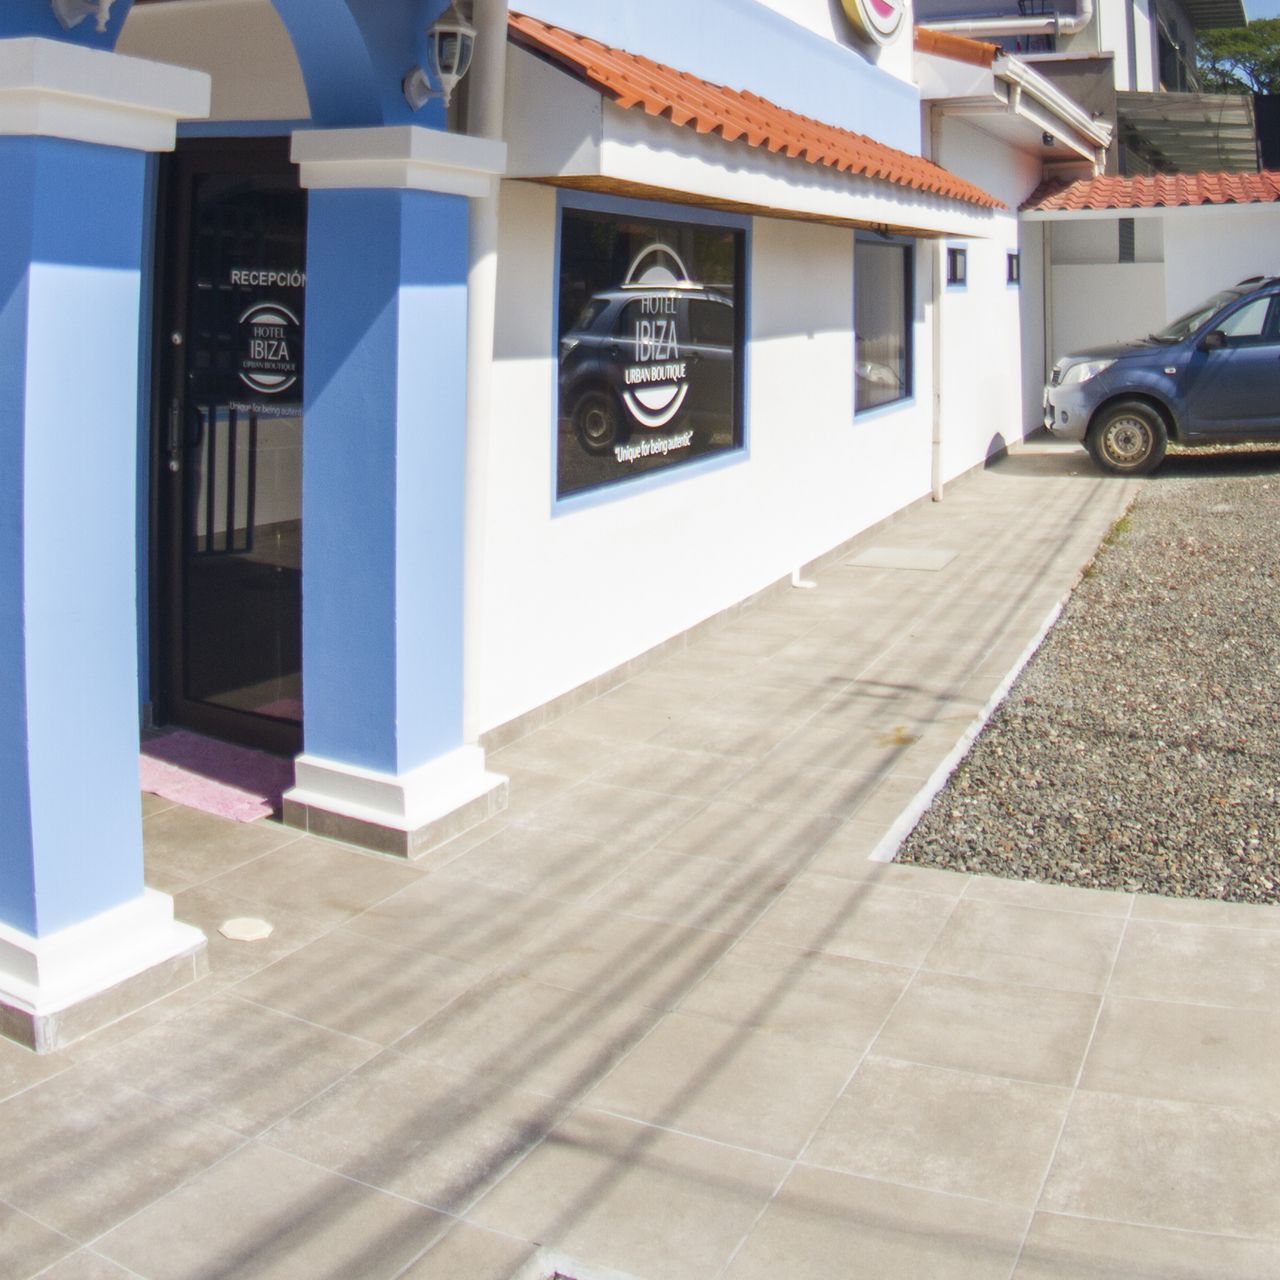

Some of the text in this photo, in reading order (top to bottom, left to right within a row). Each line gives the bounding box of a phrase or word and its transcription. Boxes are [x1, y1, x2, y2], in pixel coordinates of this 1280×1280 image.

[640, 296, 678, 315] HOTEL
[254, 326, 286, 339] HOTEL
[635, 320, 679, 363] IBIZA
[250, 339, 290, 361] IBIZA
[625, 363, 687, 385] URBAN BOUTIQUE
[650, 438, 668, 456] being
